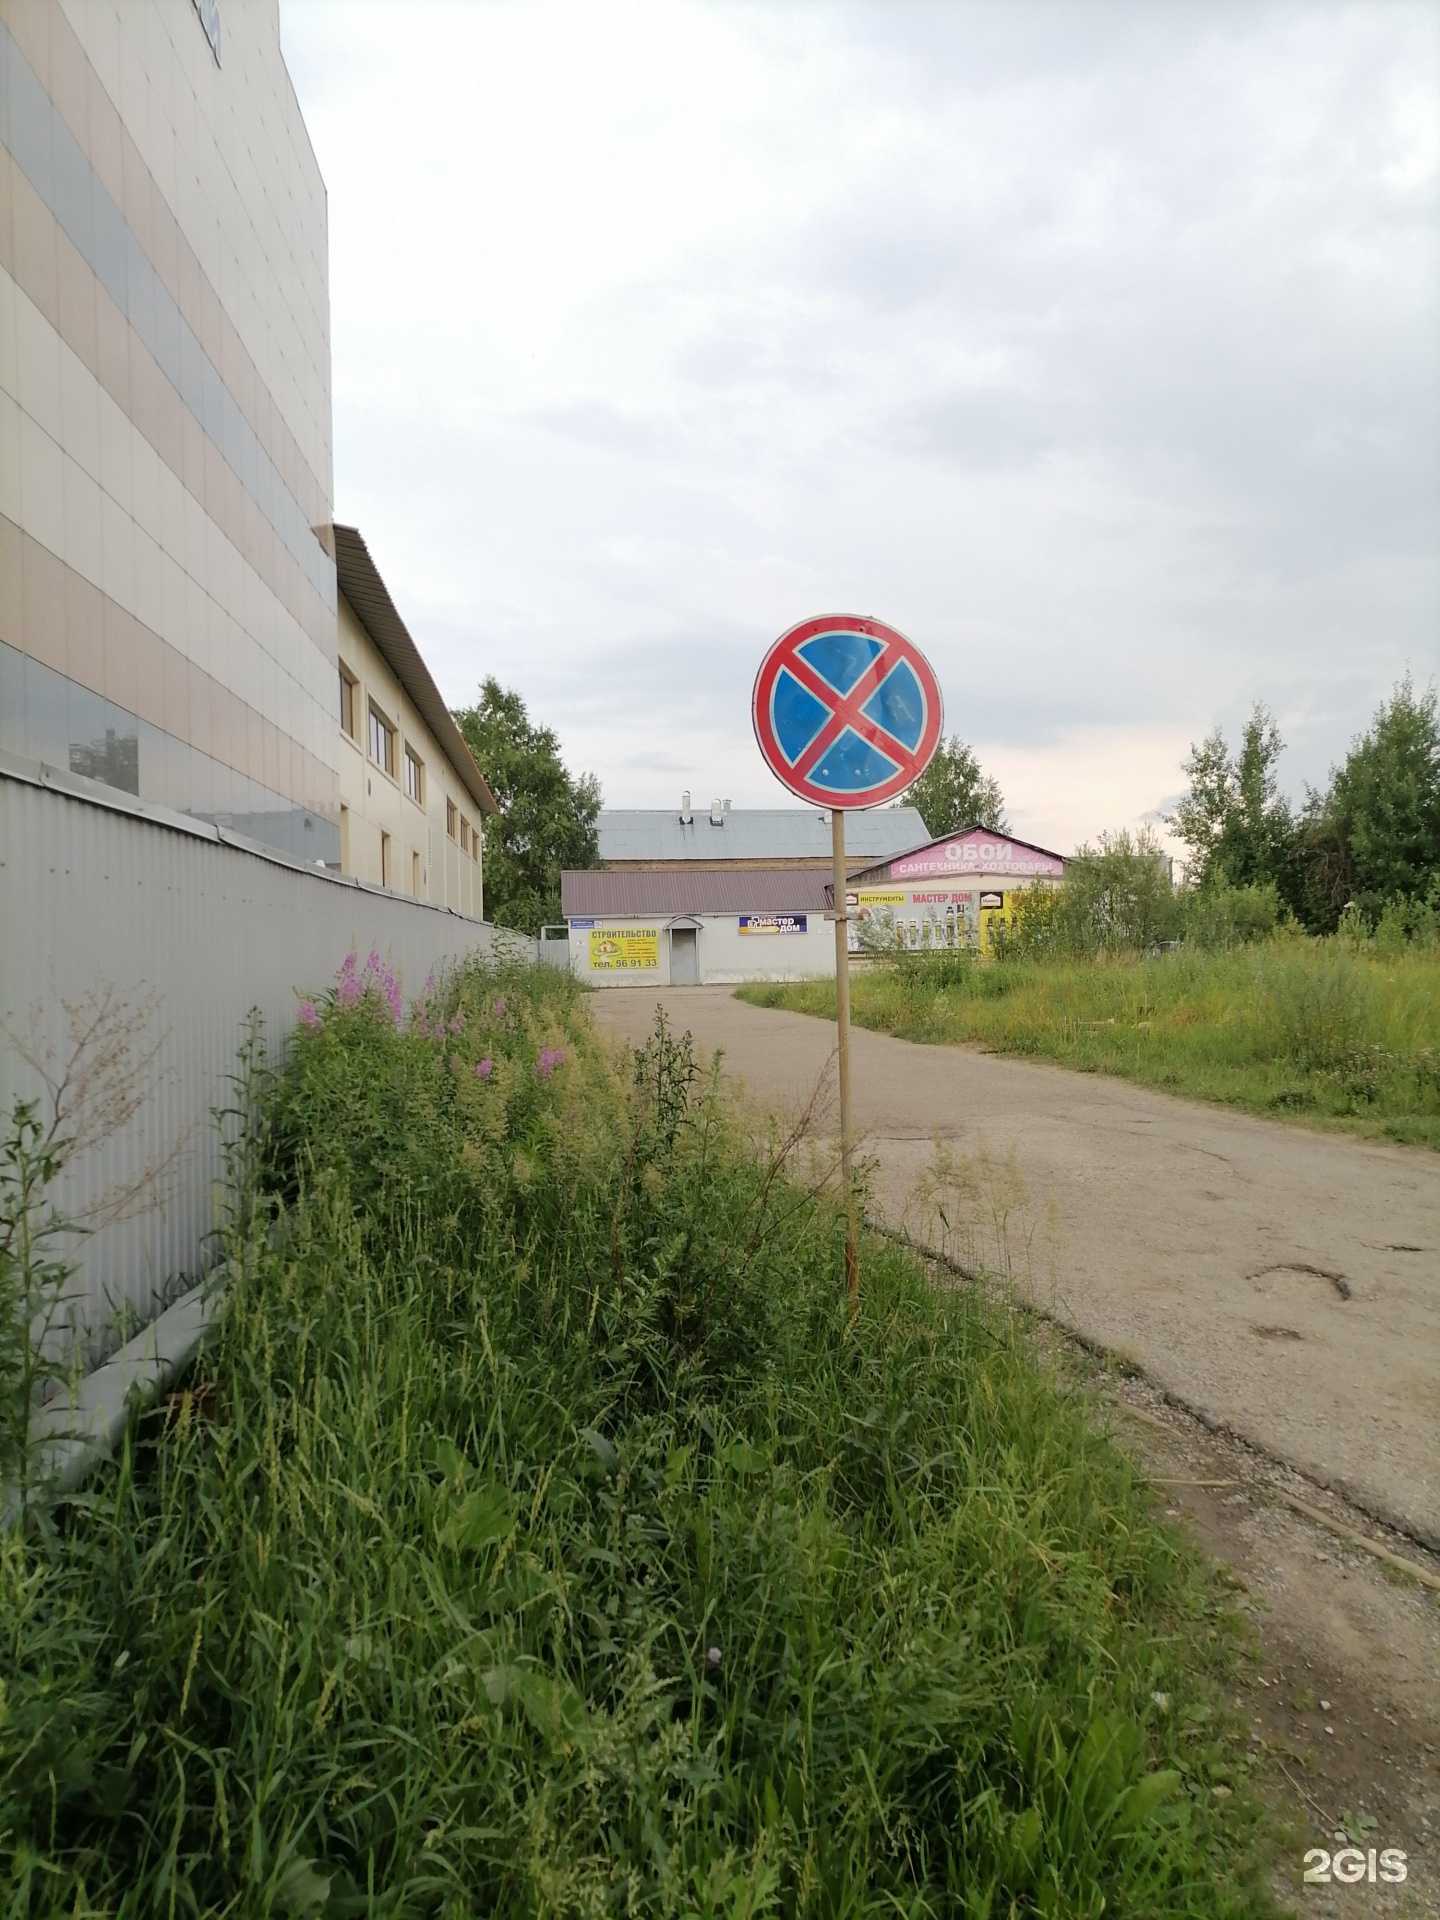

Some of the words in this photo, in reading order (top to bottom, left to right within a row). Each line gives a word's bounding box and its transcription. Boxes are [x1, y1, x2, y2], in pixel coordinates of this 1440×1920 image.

[912, 894, 948, 904] МАСТЕР
[951, 893, 972, 904] ДОМ
[760, 917, 794, 926] мастер
[780, 924, 800, 933] дом
[592, 930, 656, 938] СТРОИТЕЛЬСТВО
